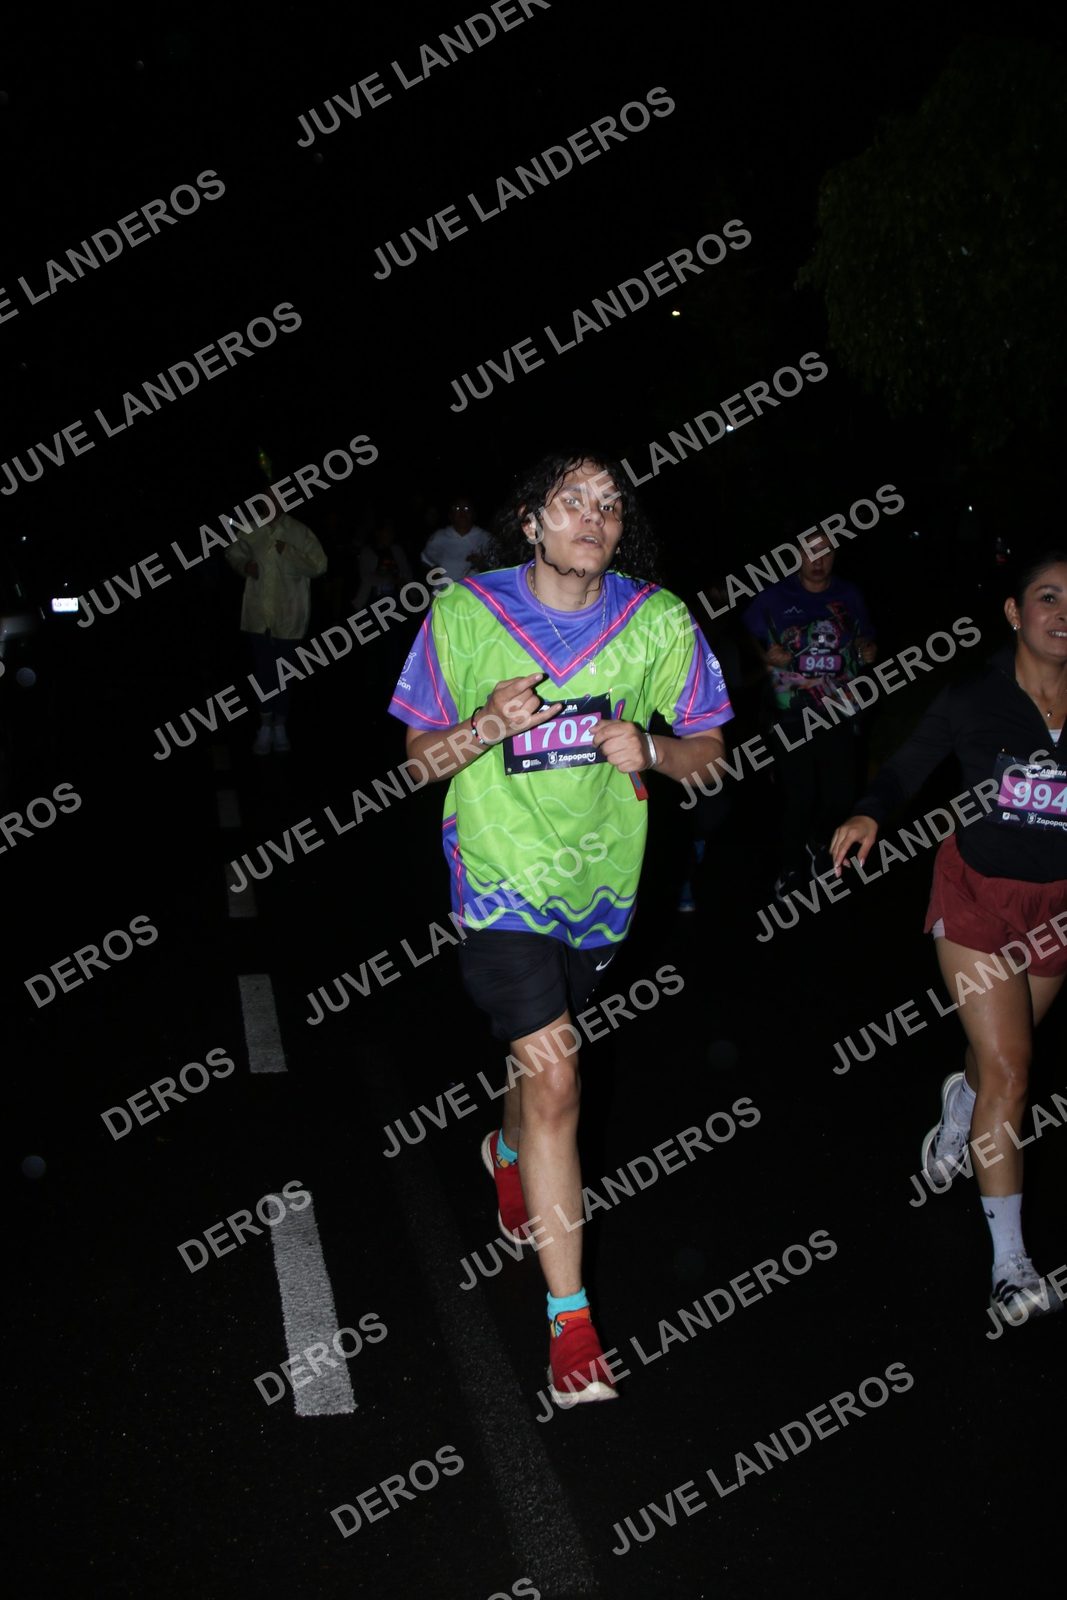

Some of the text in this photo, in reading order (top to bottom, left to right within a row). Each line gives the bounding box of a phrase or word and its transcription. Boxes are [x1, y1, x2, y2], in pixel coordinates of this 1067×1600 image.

[806, 656, 834, 671] 943
[518, 715, 599, 752] 1702
[1012, 781, 1067, 812] 994
